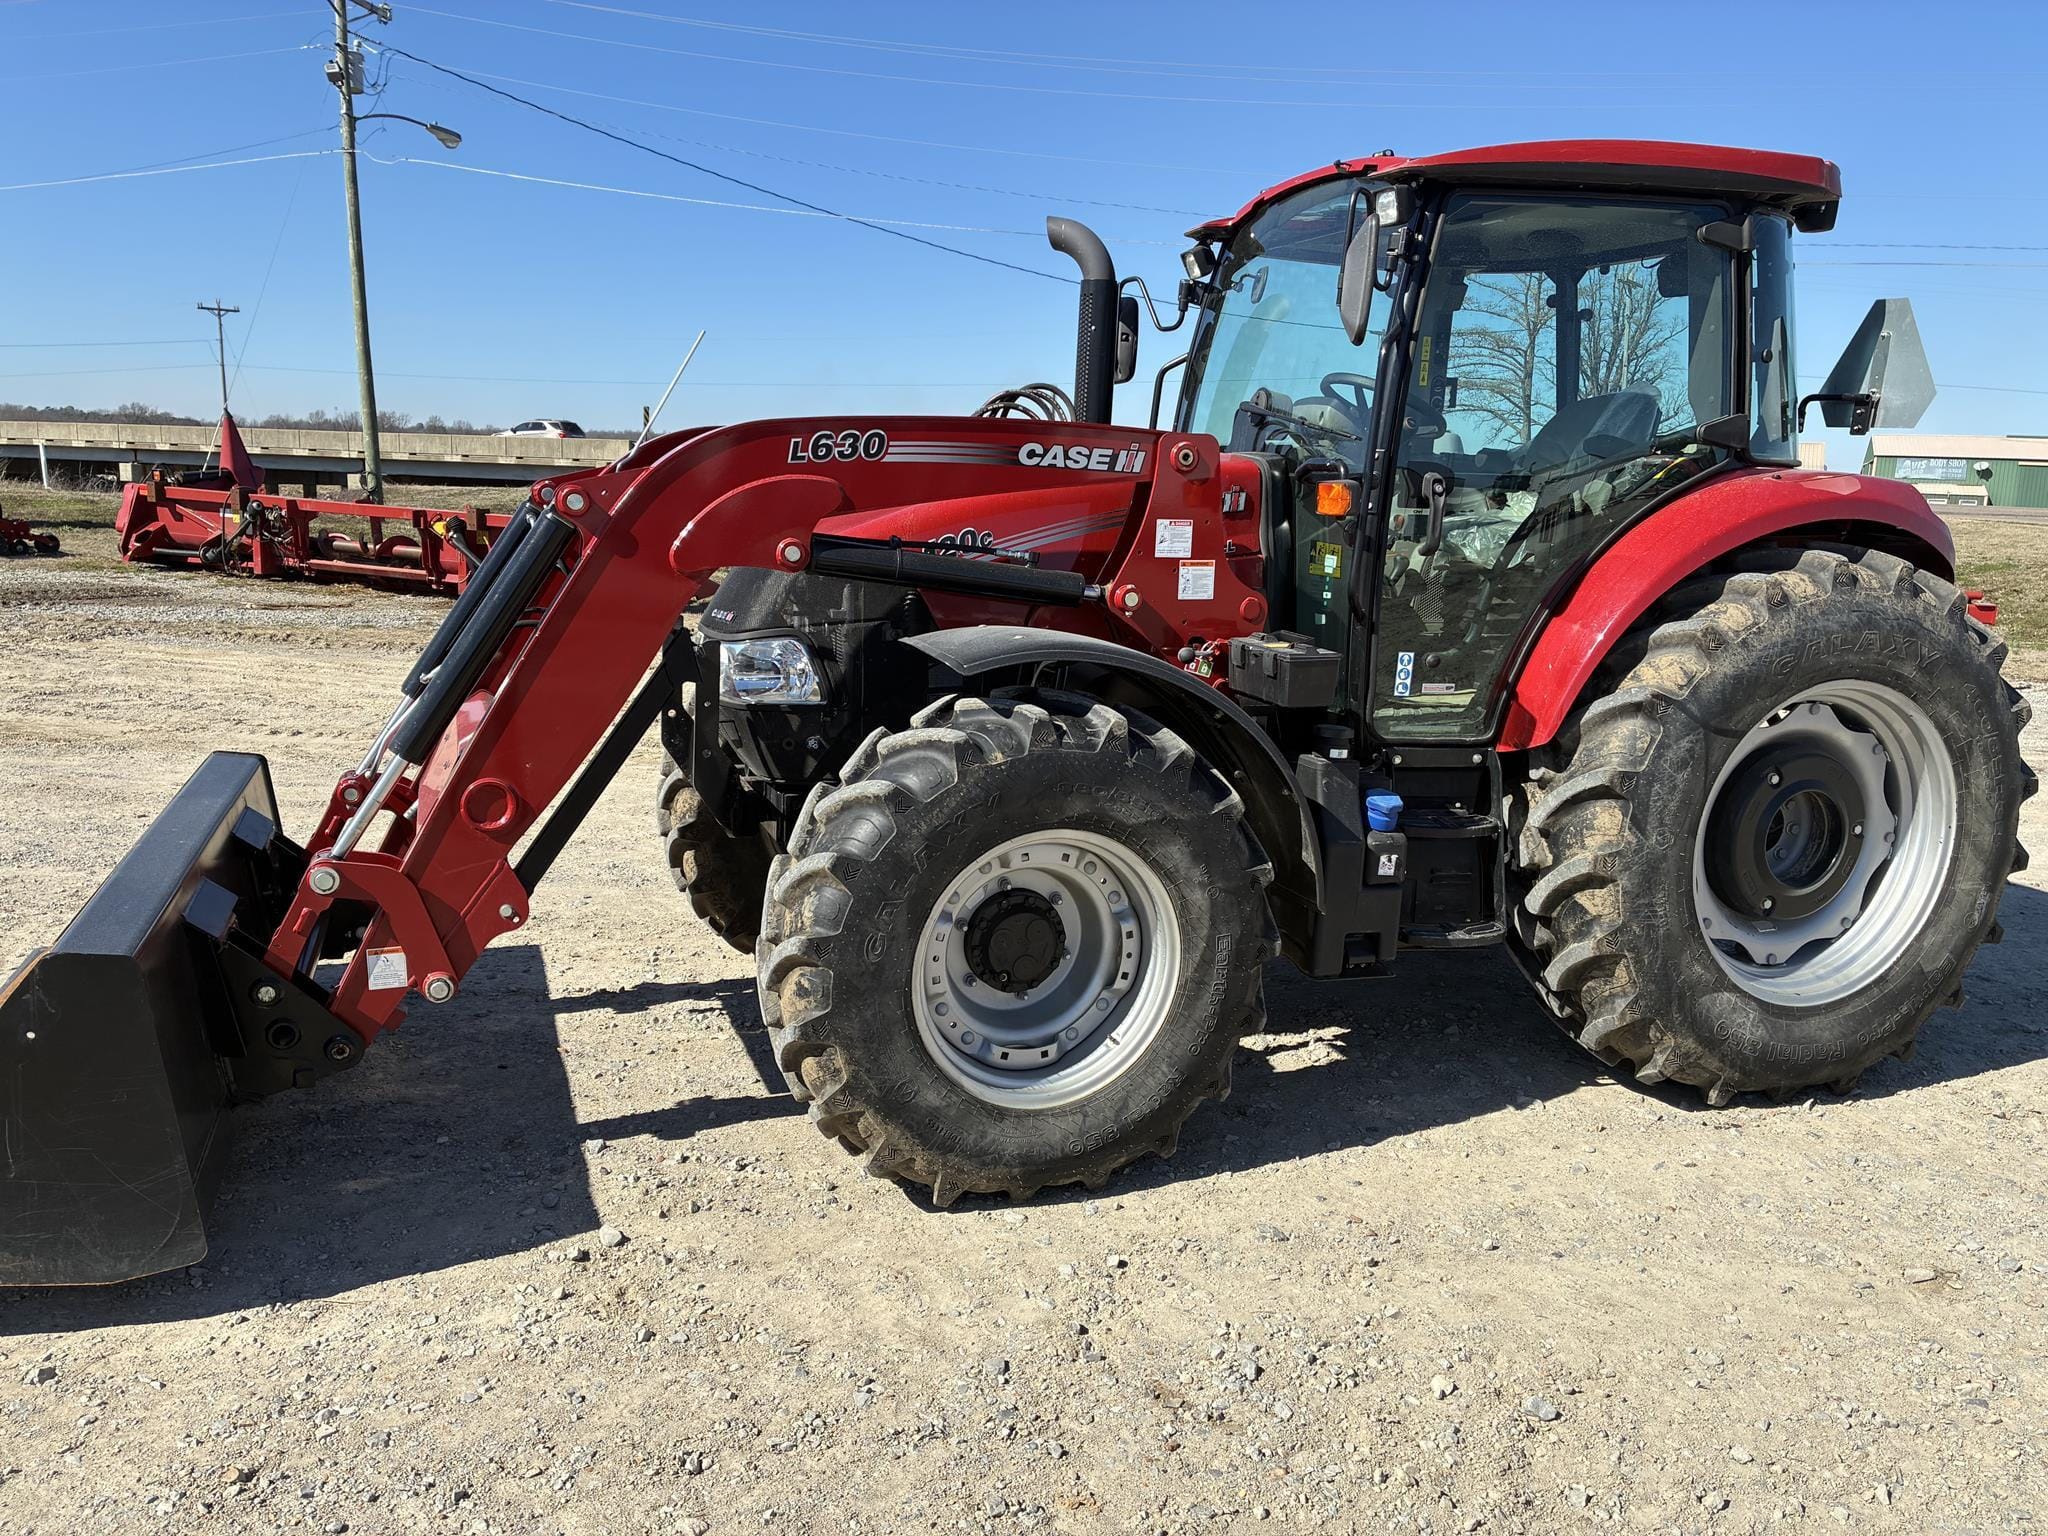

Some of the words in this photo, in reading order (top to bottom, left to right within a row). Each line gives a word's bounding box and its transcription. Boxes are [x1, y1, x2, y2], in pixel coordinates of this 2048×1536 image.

[788, 430, 888, 463] L630
[1018, 442, 1111, 471] CASE
[1948, 459, 1967, 467] SHOP
[1189, 933, 1232, 1056] Earth-Pro
[1714, 1020, 1763, 1057] 850
[1767, 1040, 1846, 1064] Radial
